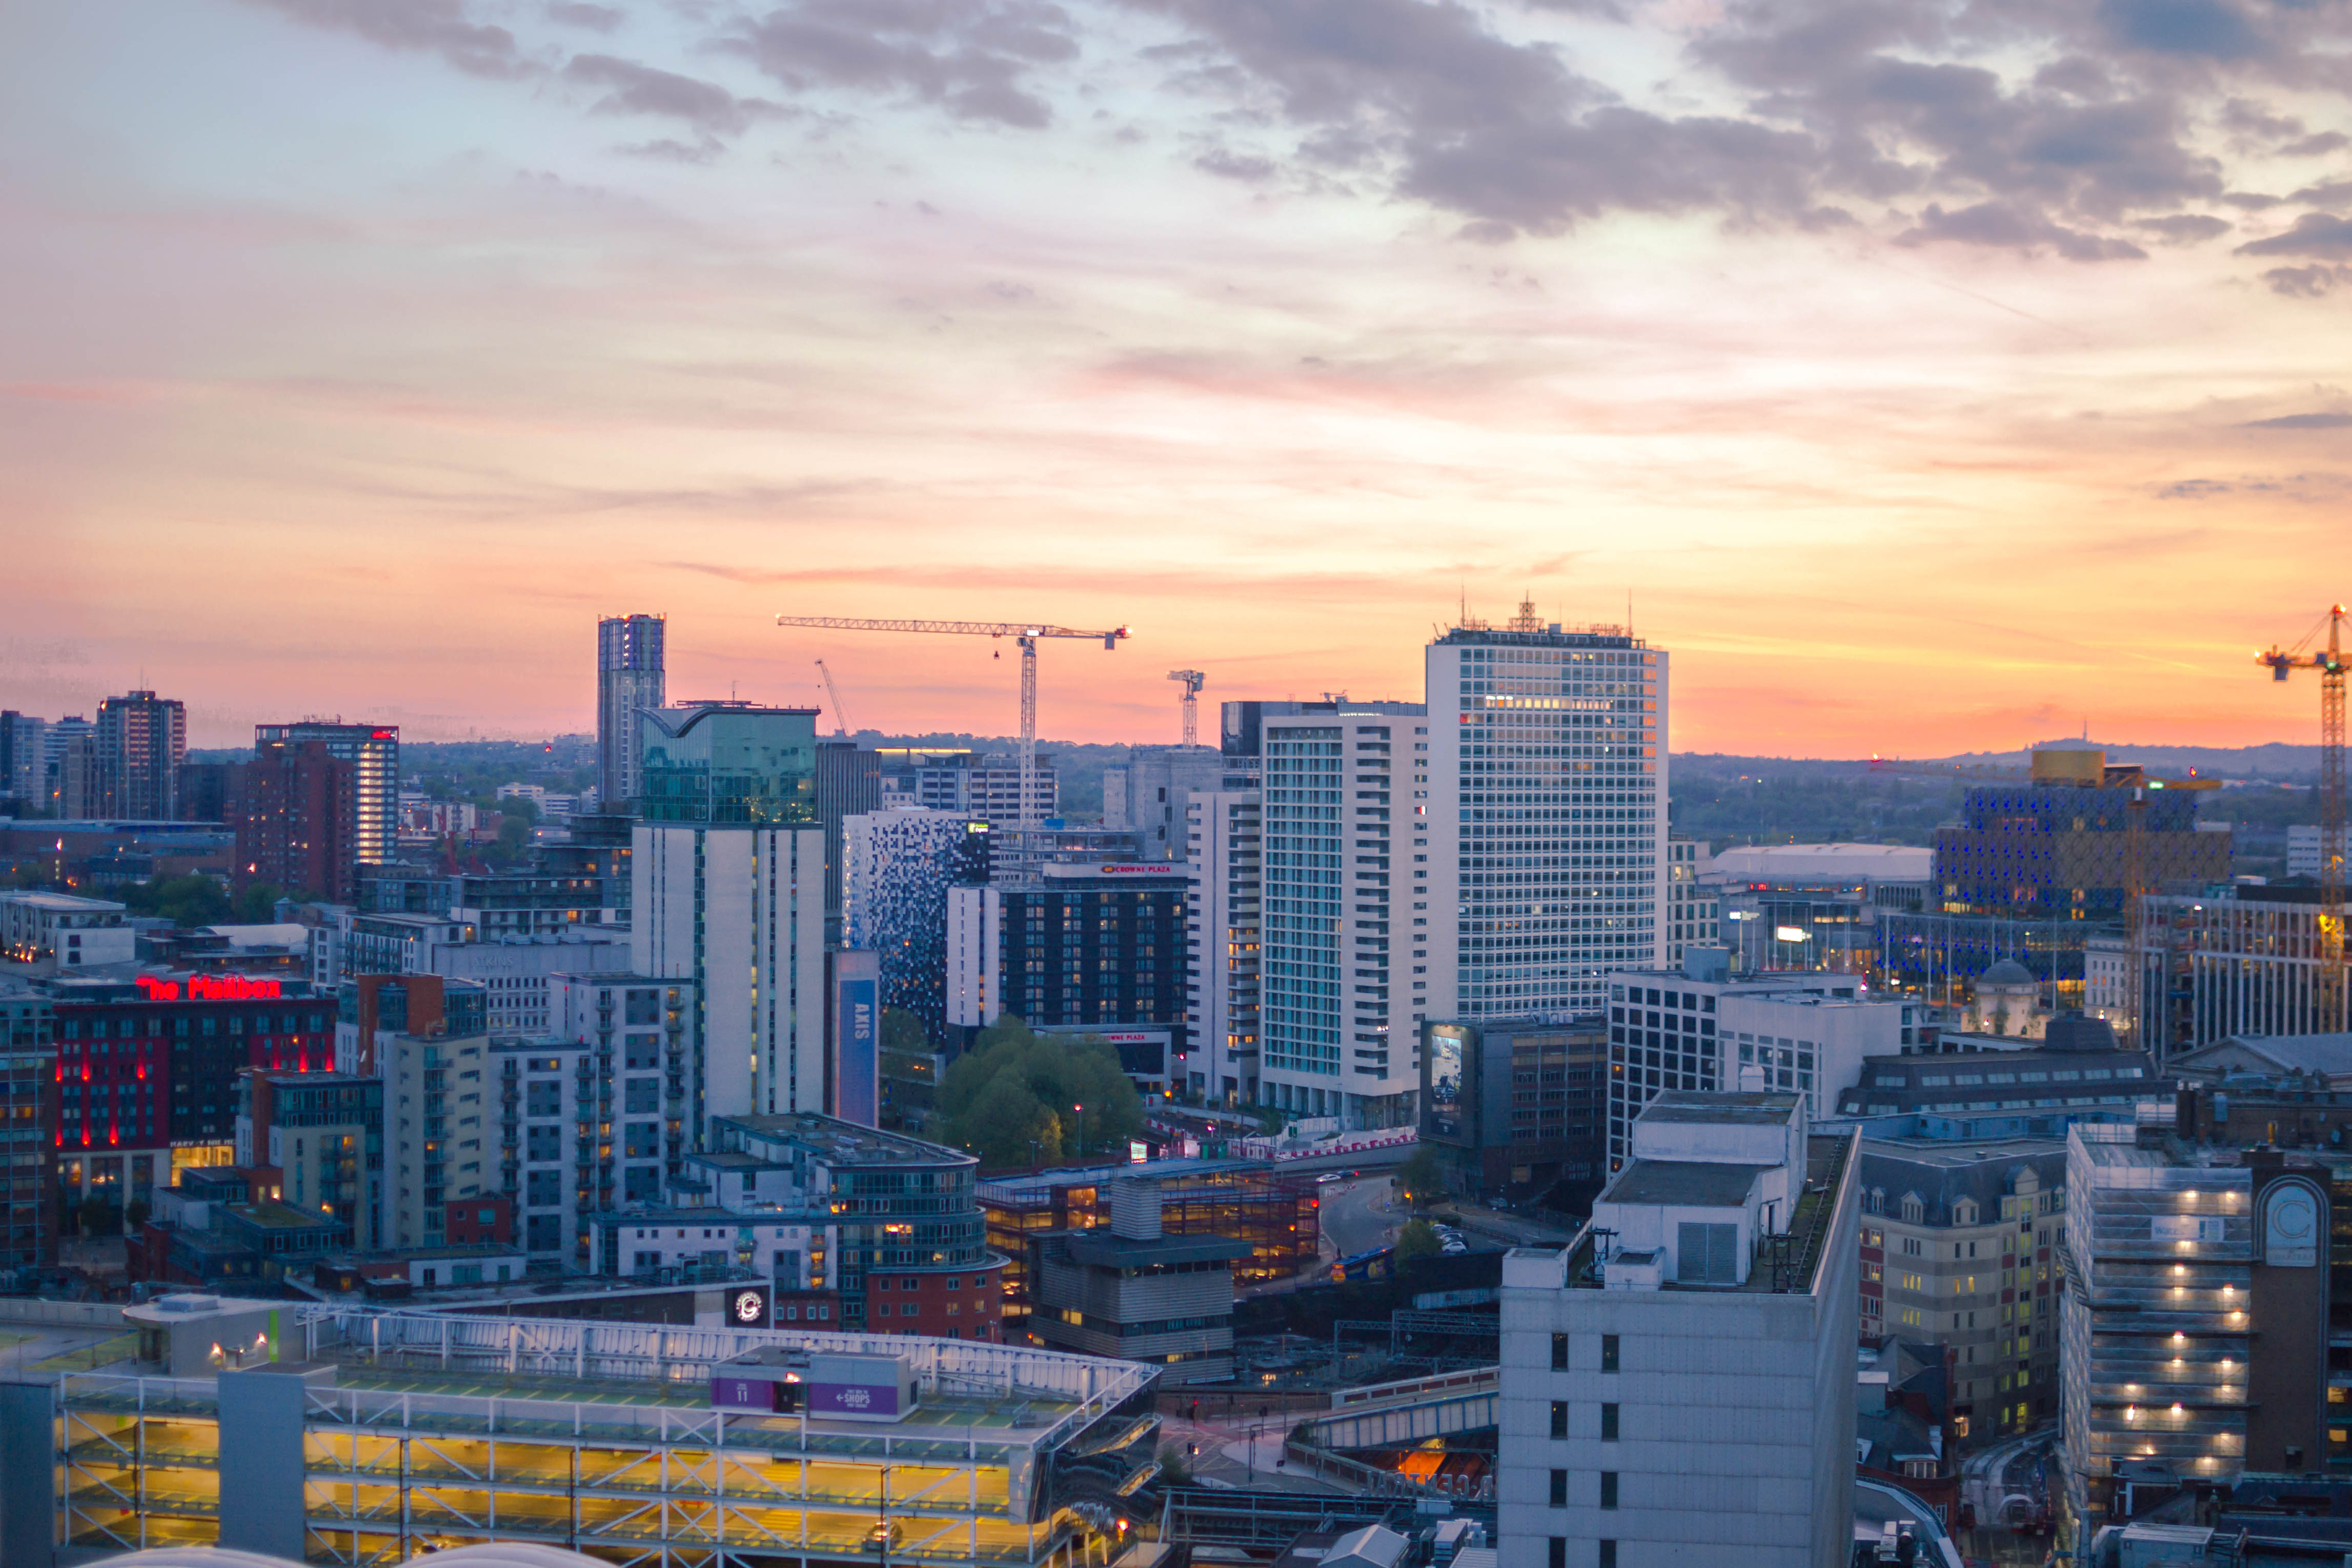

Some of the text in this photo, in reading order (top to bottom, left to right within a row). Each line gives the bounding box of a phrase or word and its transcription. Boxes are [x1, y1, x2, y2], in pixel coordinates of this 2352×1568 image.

[135, 975, 281, 1000] The Mailbox
[855, 1004, 870, 1040] AXIS
[738, 1390, 747, 1401] 11
[844, 1393, 870, 1403] SHOPS
